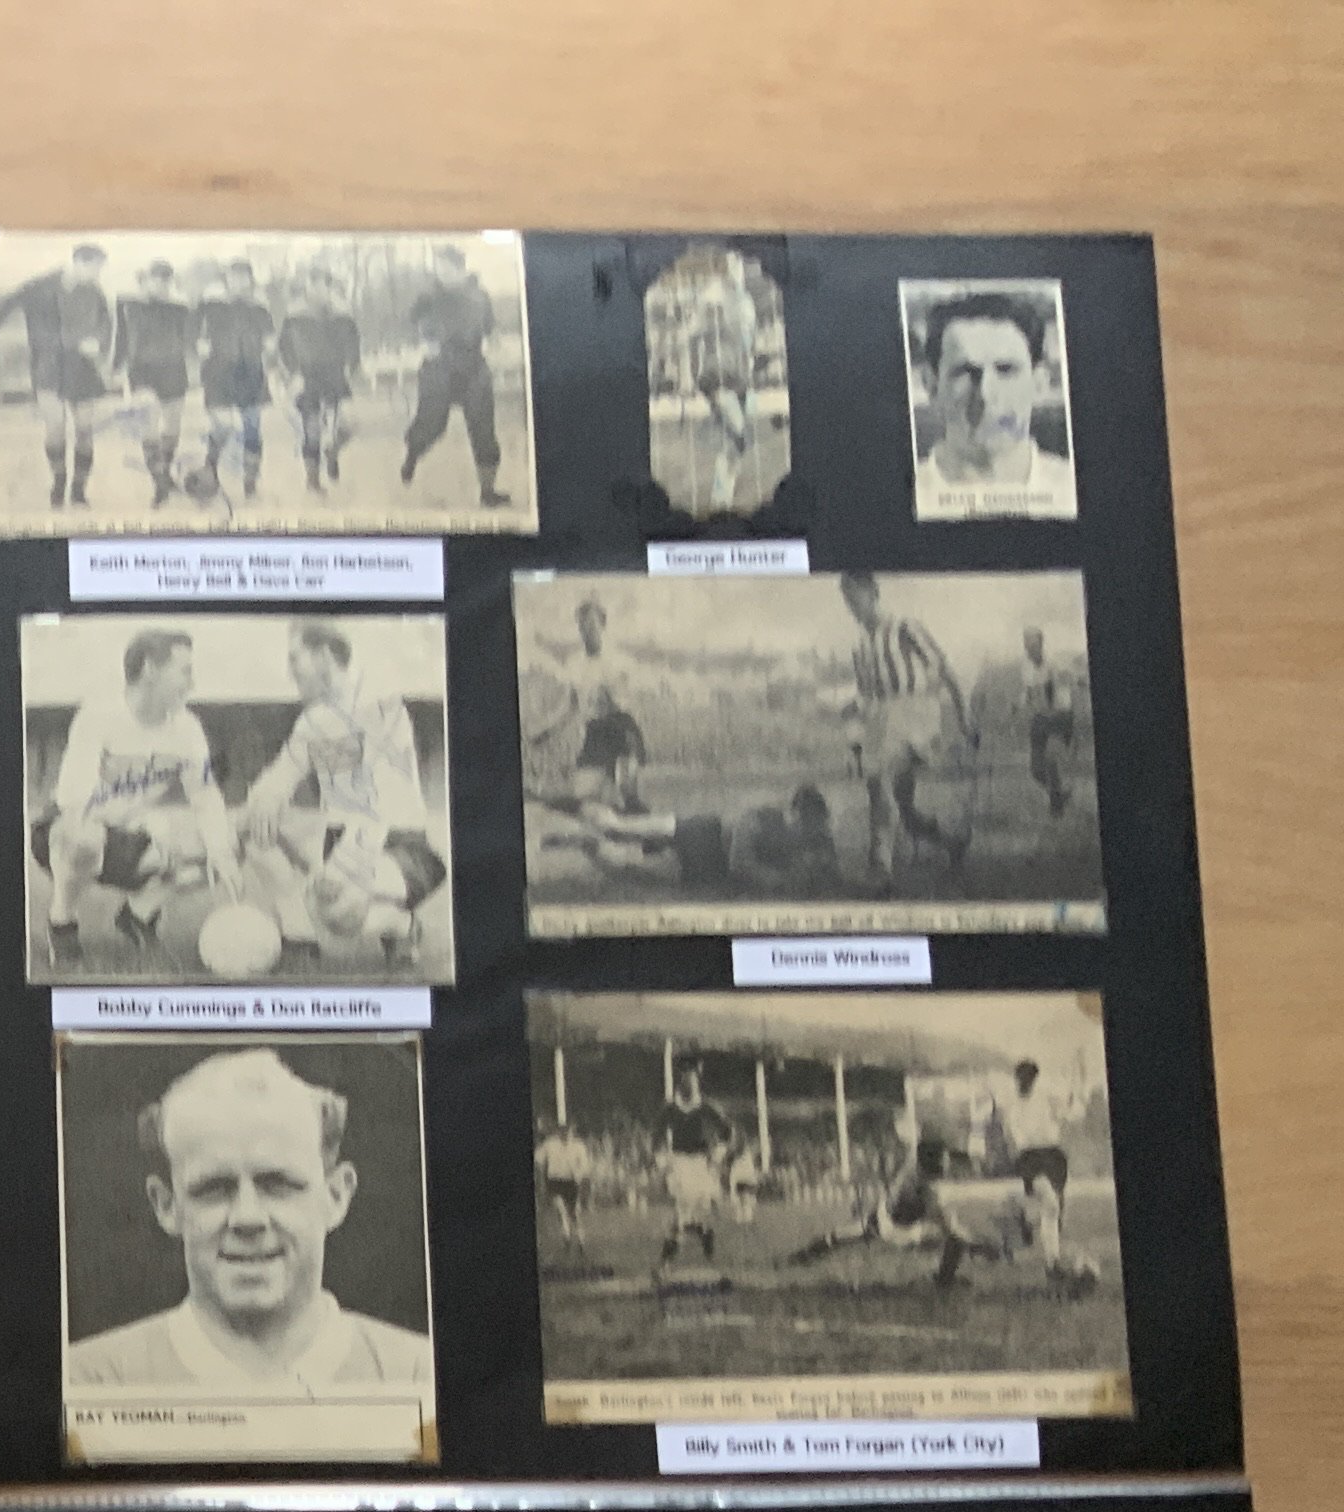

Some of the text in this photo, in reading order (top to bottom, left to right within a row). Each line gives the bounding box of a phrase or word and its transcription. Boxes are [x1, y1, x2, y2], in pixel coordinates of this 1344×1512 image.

[730, 548, 786, 565] Hunter
[237, 574, 248, 589] &
[771, 949, 828, 968] Dennis
[97, 998, 151, 1019] Bobby
[252, 999, 265, 1016] &
[272, 999, 305, 1016] Don
[76, 1411, 104, 1425] RAY
[684, 1435, 1006, 1458] Billy Smith & Tom Forgan (York City)
